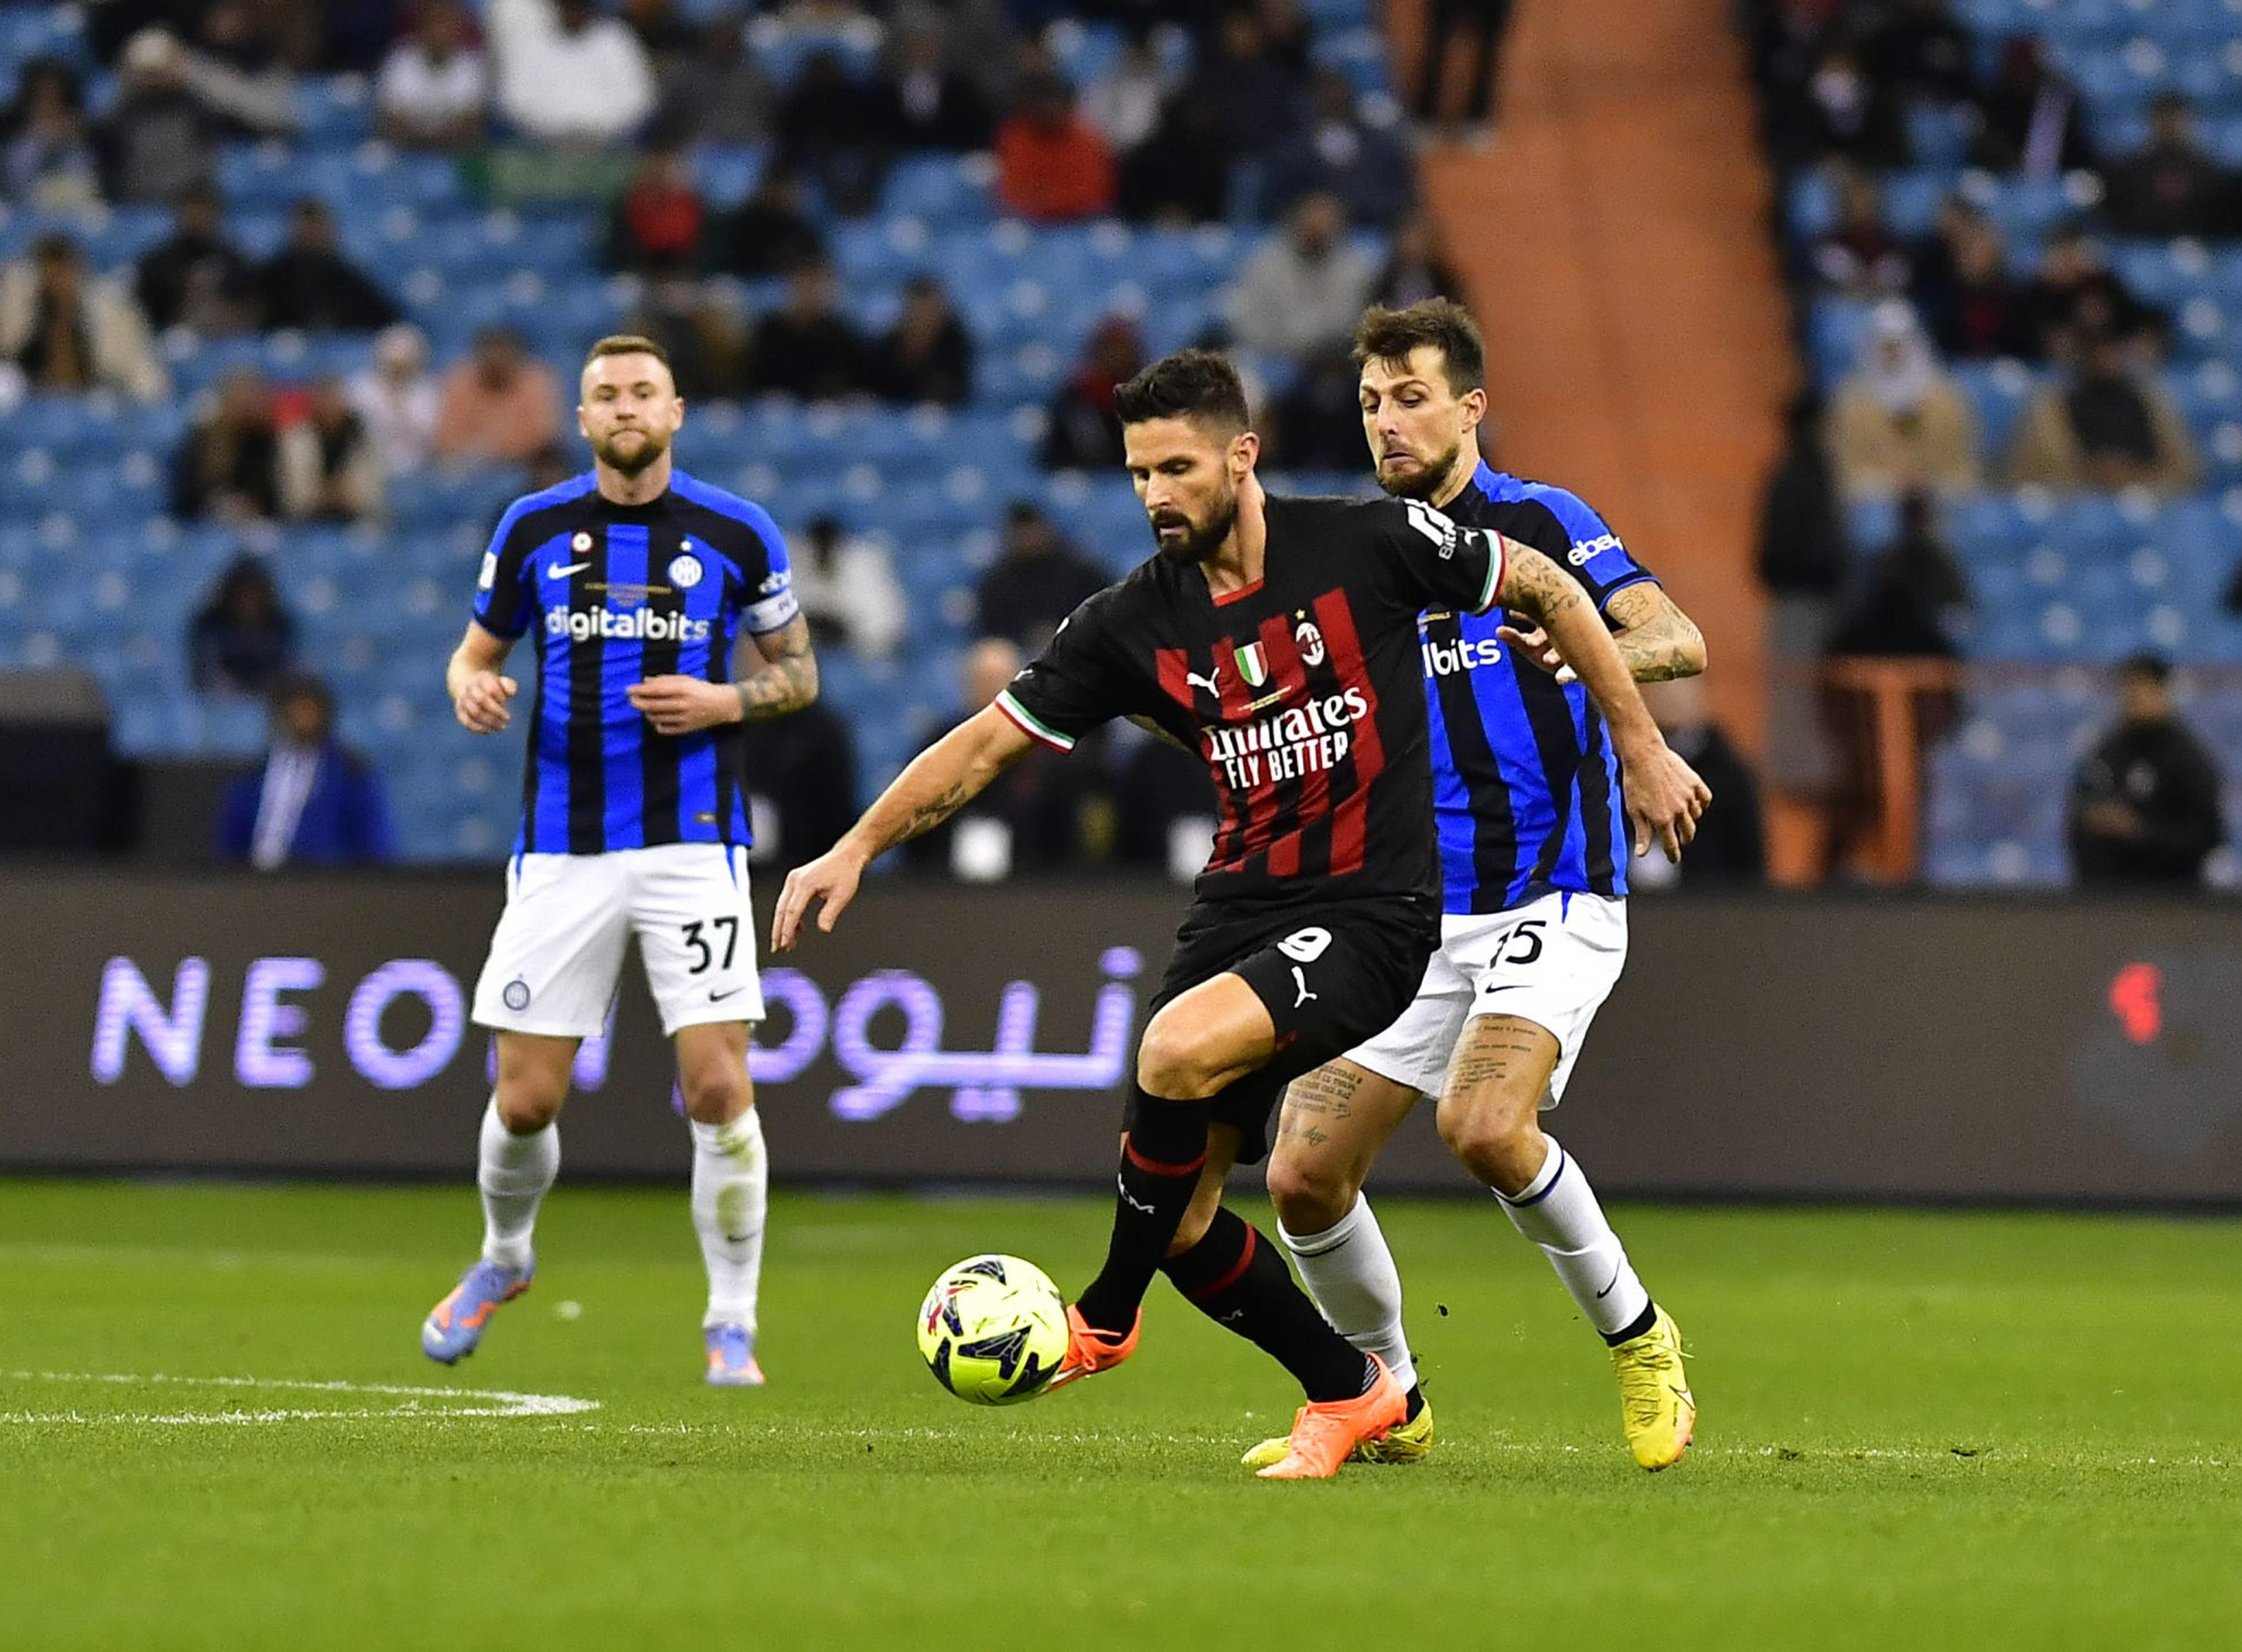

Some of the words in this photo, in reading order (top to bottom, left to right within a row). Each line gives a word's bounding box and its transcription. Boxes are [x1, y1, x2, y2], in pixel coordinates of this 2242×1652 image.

[544, 604, 709, 642] digitalbits
[1421, 638, 1501, 678] lbits
[1225, 754, 1260, 790] FLY
[1267, 730, 1349, 782] BETTER
[681, 916, 739, 974] 37
[89, 954, 615, 1093] NEO
